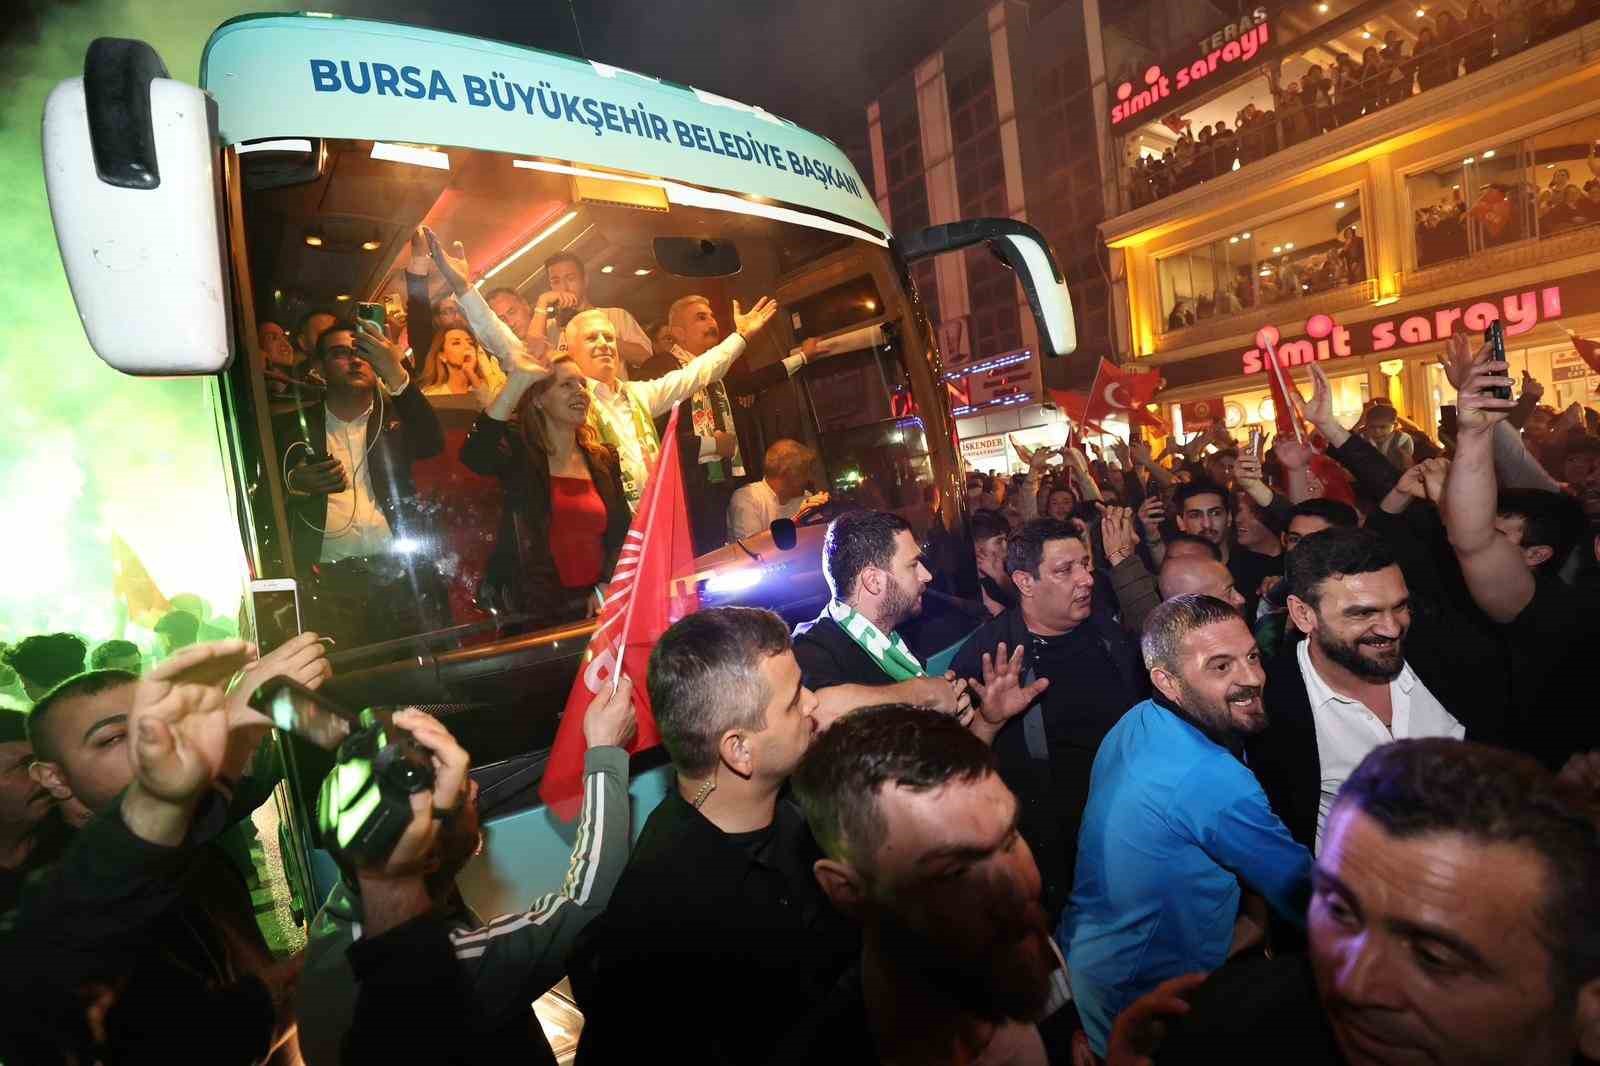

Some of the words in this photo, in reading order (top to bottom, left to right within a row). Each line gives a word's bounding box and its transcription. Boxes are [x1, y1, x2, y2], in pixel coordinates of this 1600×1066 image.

[1199, 6, 1267, 54] TERAS
[1112, 66, 1170, 124] simit
[310, 59, 457, 103] BURSA
[463, 71, 672, 144] BÜYÜKŞEHİR
[673, 119, 787, 171] BELEDİYE
[787, 150, 862, 200] BAŞKANI
[1243, 315, 1352, 374] simit
